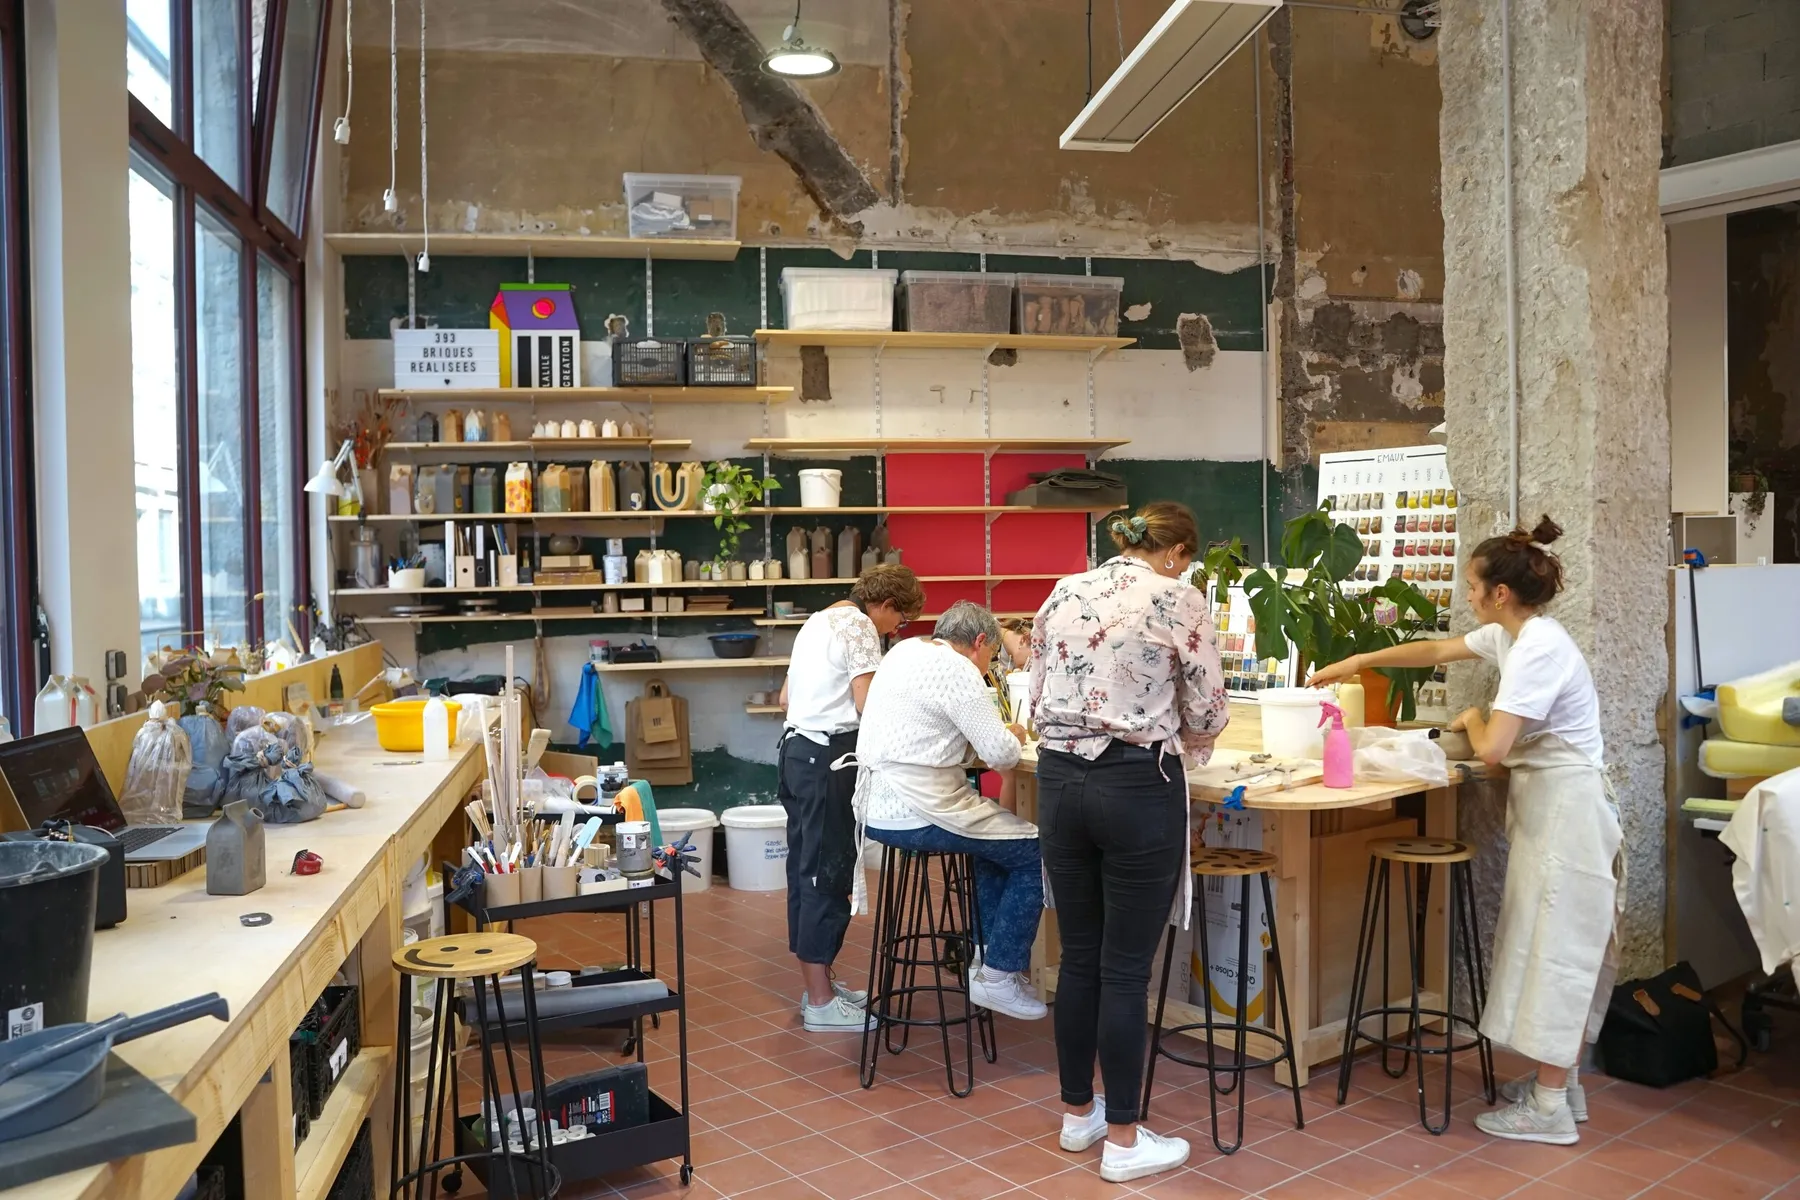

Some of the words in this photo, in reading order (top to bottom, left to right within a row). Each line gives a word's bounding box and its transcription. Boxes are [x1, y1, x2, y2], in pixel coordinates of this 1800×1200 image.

[435, 333, 456, 343] 393
[423, 347, 473, 358] BRIQUES
[410, 362, 476, 373] REALISEES
[562, 340, 571, 387] CREATION
[541, 355, 550, 387] LALILE
[1215, 964, 1234, 978] Close
